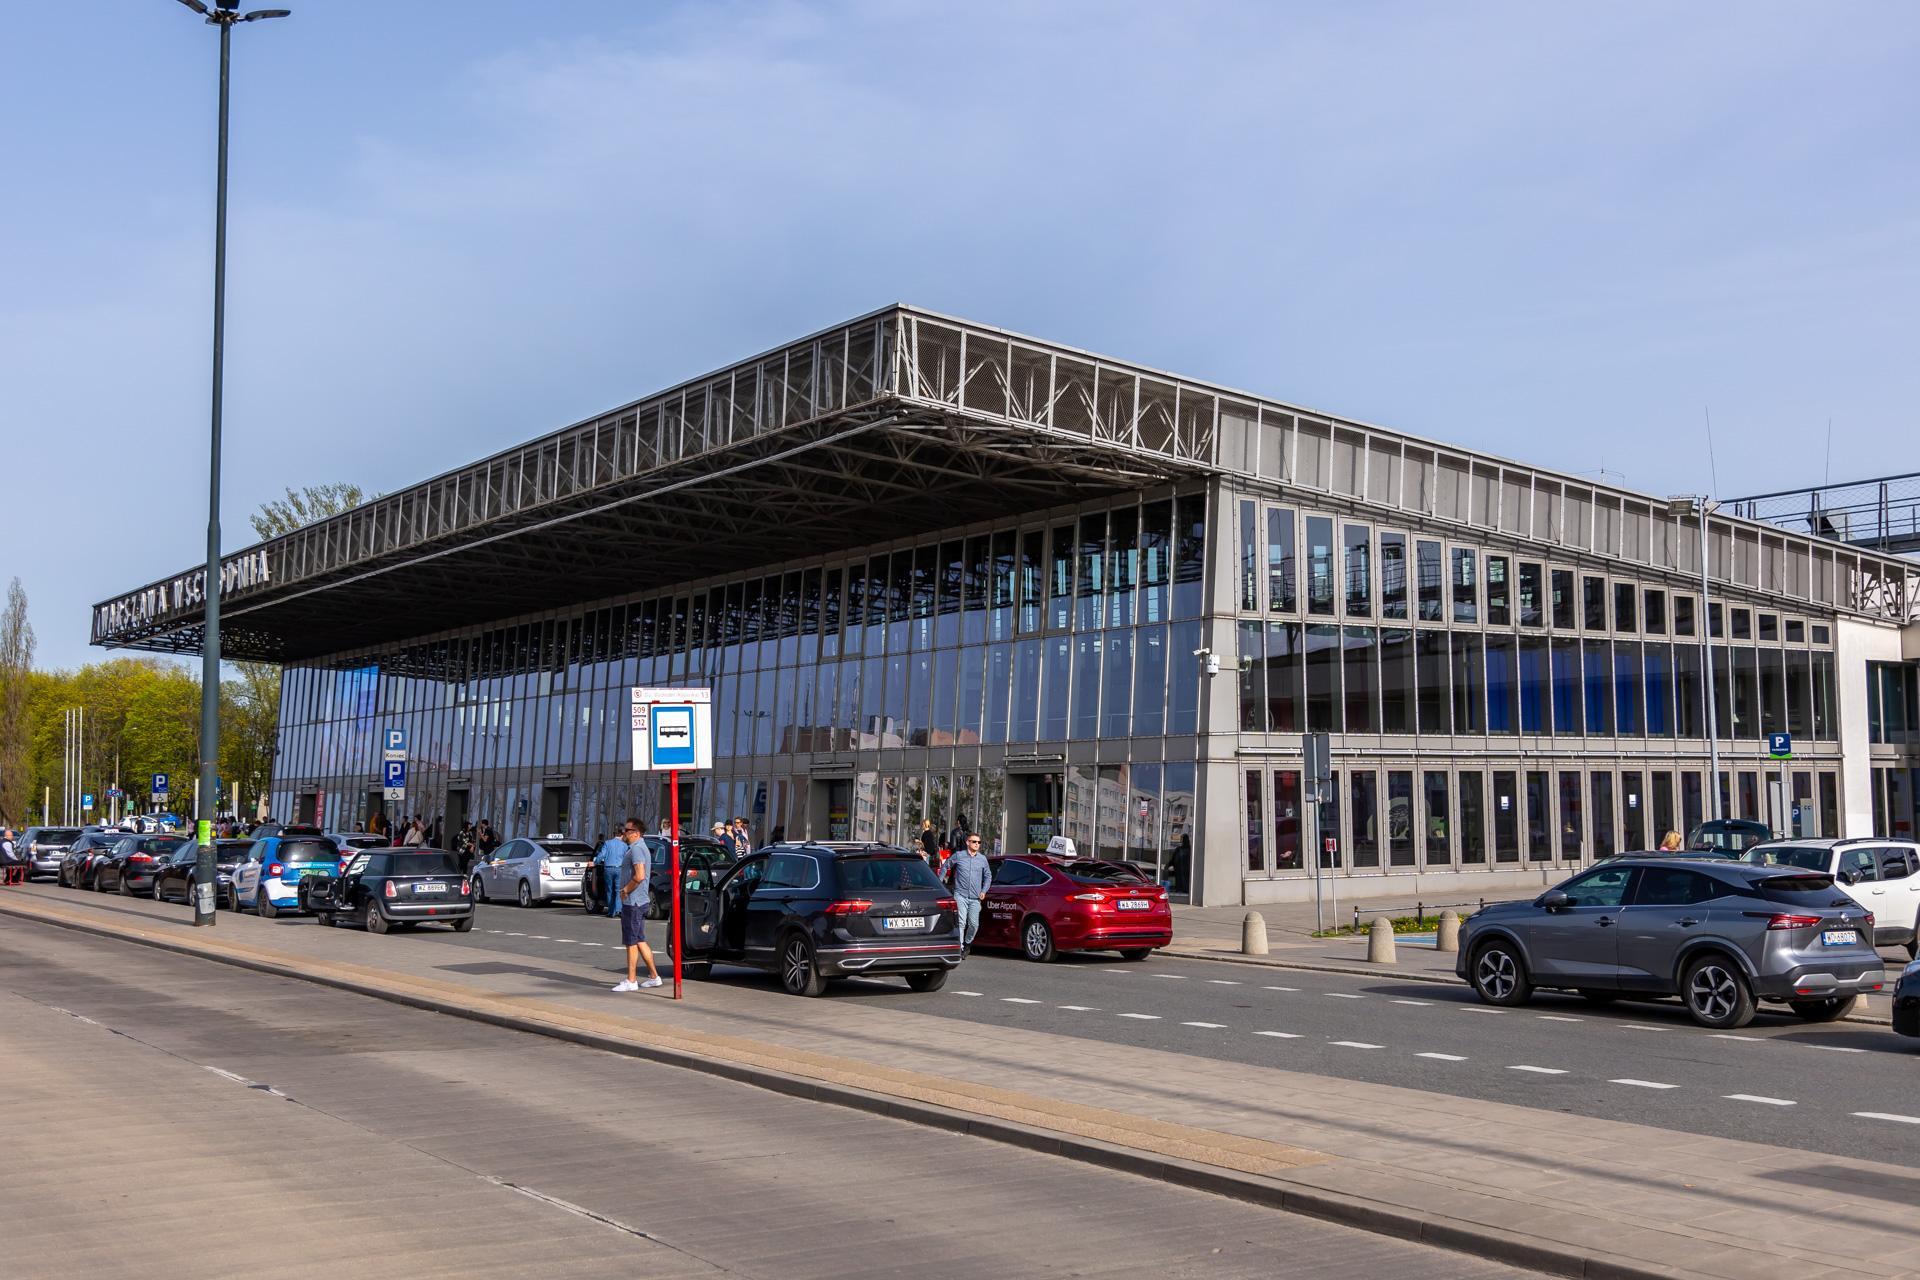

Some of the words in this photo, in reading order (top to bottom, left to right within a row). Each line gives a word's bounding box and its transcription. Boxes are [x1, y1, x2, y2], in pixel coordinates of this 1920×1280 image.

[101, 585, 168, 637] WARSZAWA
[173, 550, 270, 609] WSCDNIA
[633, 706, 646, 714] 509
[634, 719, 645, 727] 512
[390, 731, 403, 748] P
[1775, 736, 1784, 747] P
[389, 763, 401, 780] P
[156, 775, 165, 788] P
[1051, 840, 1064, 850] Uber
[987, 901, 1000, 909] Uber
[1000, 901, 1017, 911] Airport
[888, 919, 899, 927] WX
[901, 918, 923, 927] 3112E
